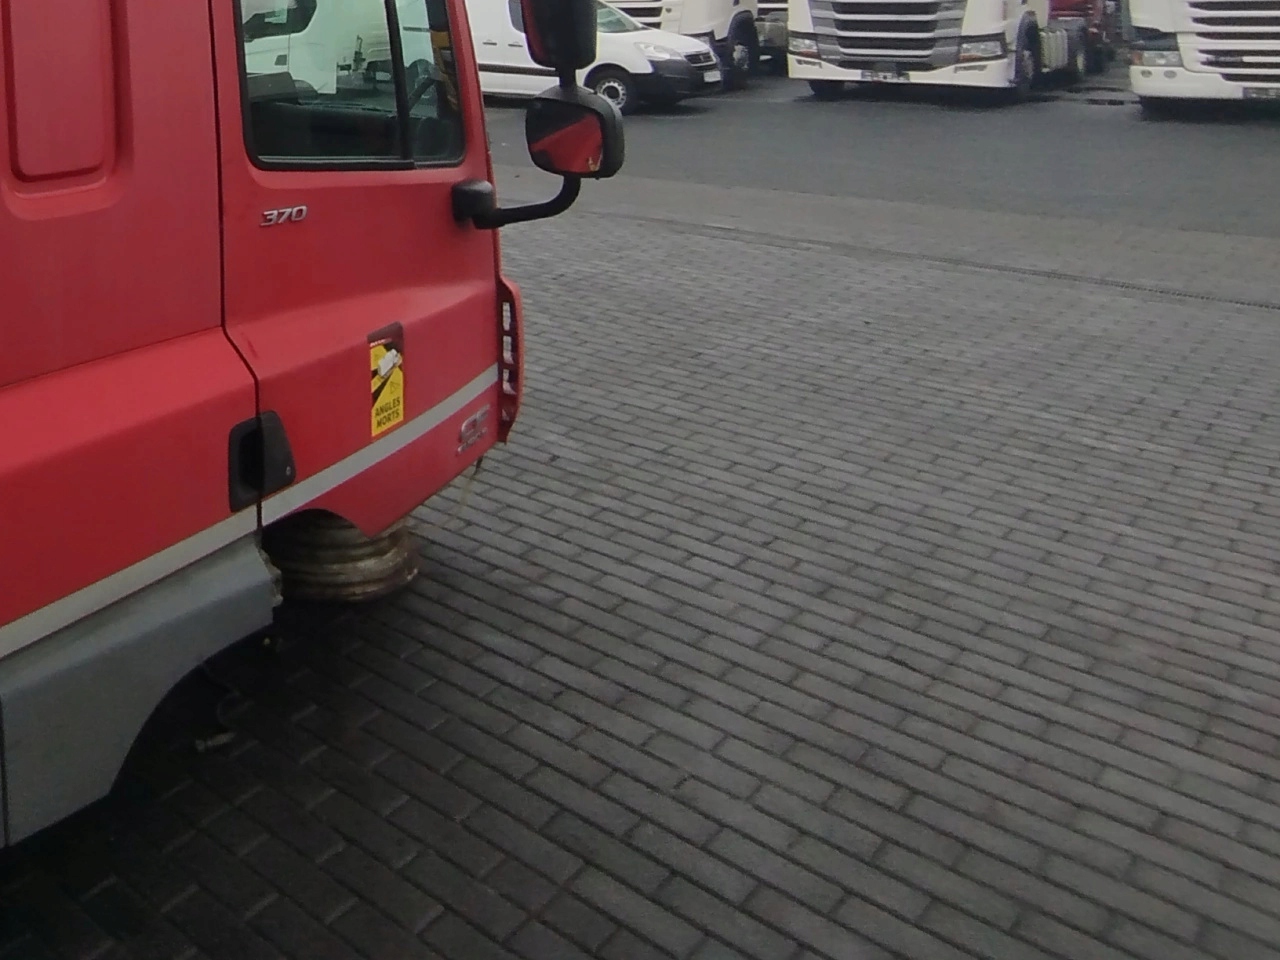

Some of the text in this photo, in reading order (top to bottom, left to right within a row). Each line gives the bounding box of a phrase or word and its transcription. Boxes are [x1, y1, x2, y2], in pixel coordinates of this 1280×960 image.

[260, 205, 307, 227] 370
[374, 396, 401, 417] ANGLES
[376, 408, 401, 428] MORTS
